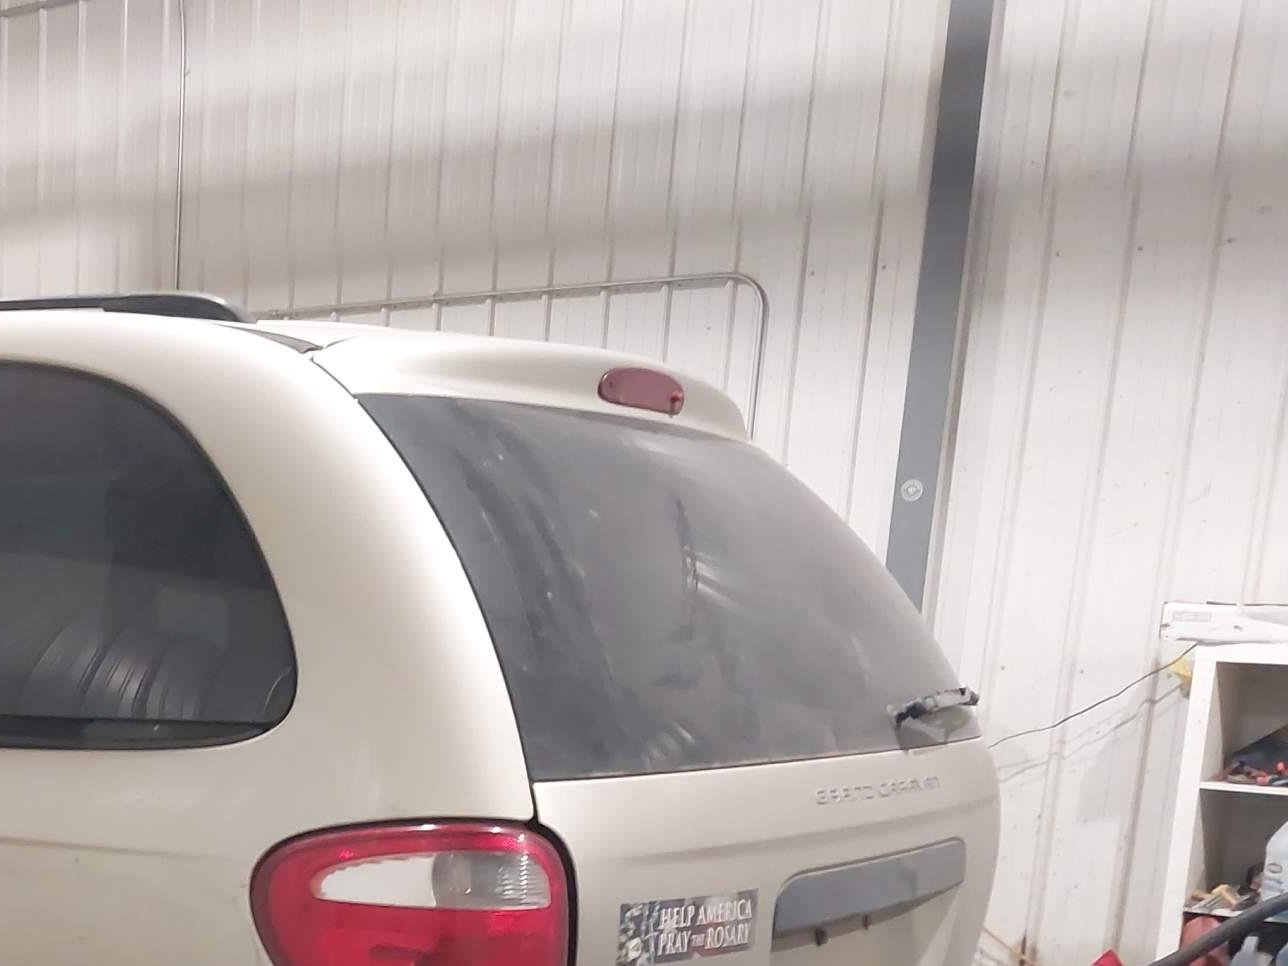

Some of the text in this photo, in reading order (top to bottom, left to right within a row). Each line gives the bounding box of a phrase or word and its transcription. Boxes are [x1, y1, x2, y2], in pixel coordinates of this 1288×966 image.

[658, 899, 753, 930] HELP AMERICA
[656, 930, 692, 956] PRAY
[704, 922, 751, 950] ROSARY
